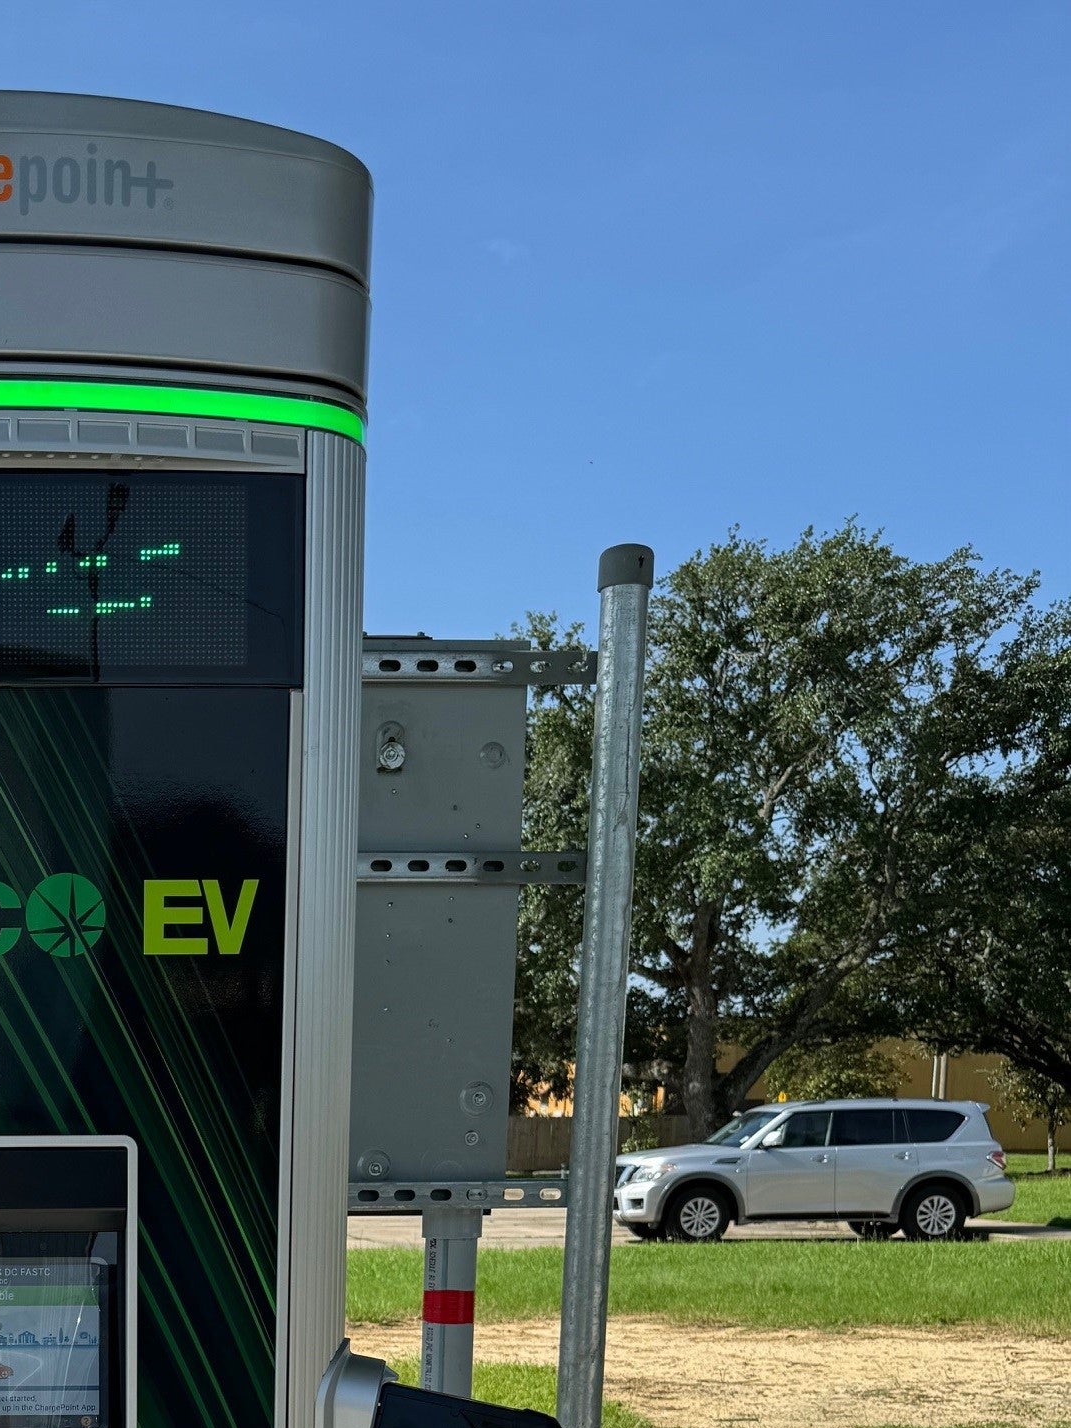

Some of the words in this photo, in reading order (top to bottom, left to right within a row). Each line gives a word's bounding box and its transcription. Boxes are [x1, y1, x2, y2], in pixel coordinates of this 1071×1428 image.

[143, 879, 260, 955] EV
[4, 1268, 18, 1277] DC
[20, 1267, 51, 1276] FASTC
[34, 1404, 79, 1413] ChargePoint
